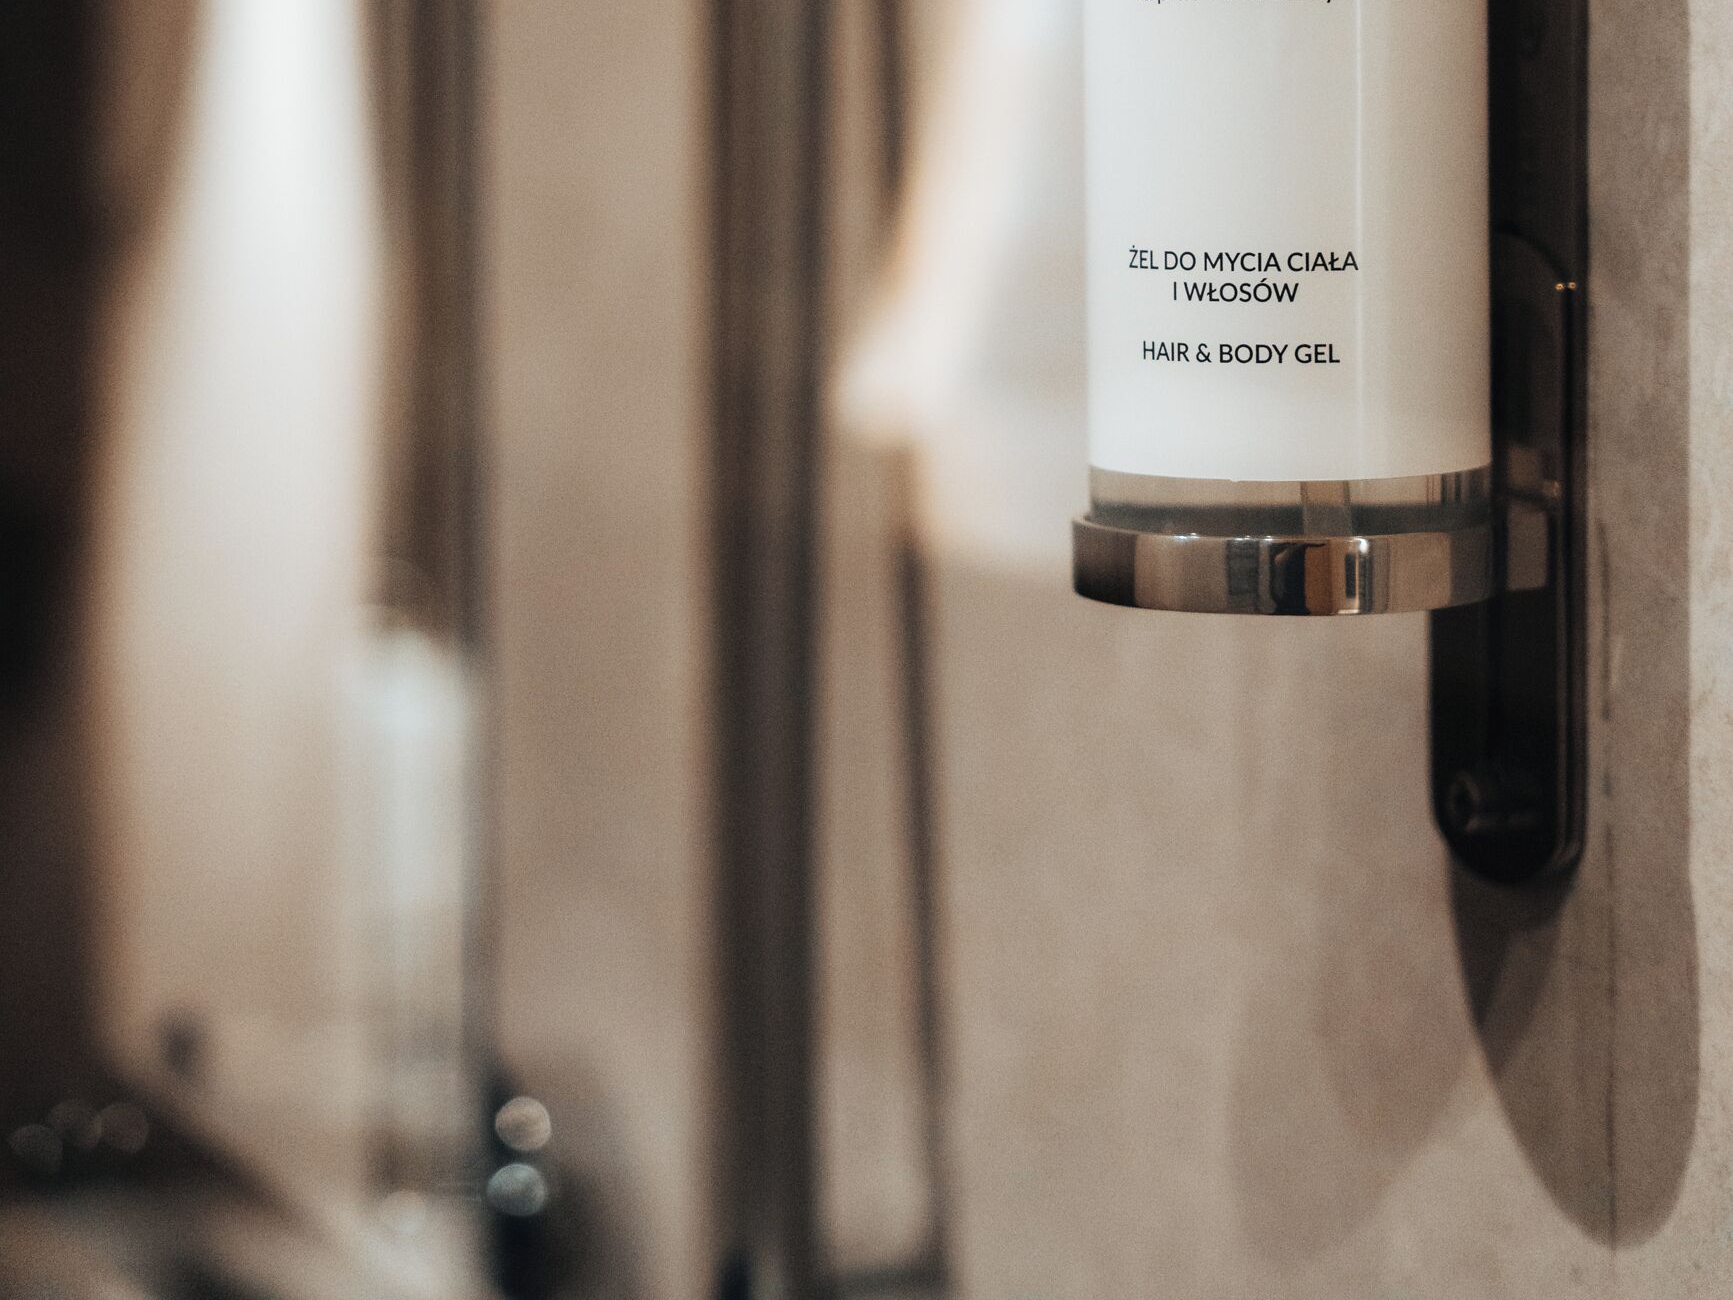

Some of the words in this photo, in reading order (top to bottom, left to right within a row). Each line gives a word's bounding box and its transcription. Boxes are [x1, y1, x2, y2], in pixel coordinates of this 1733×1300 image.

[1128, 245, 1159, 270] ŻEL
[1163, 250, 1197, 271] DO
[1203, 251, 1282, 272] MYCIA
[1286, 250, 1359, 272] CIAŁA
[1172, 281, 1178, 301] I
[1183, 277, 1300, 303] WŁOSÓW
[1142, 340, 1190, 362] HAIR
[1195, 342, 1213, 363] &
[1218, 343, 1289, 364] BODY
[1294, 343, 1341, 364] GEL
